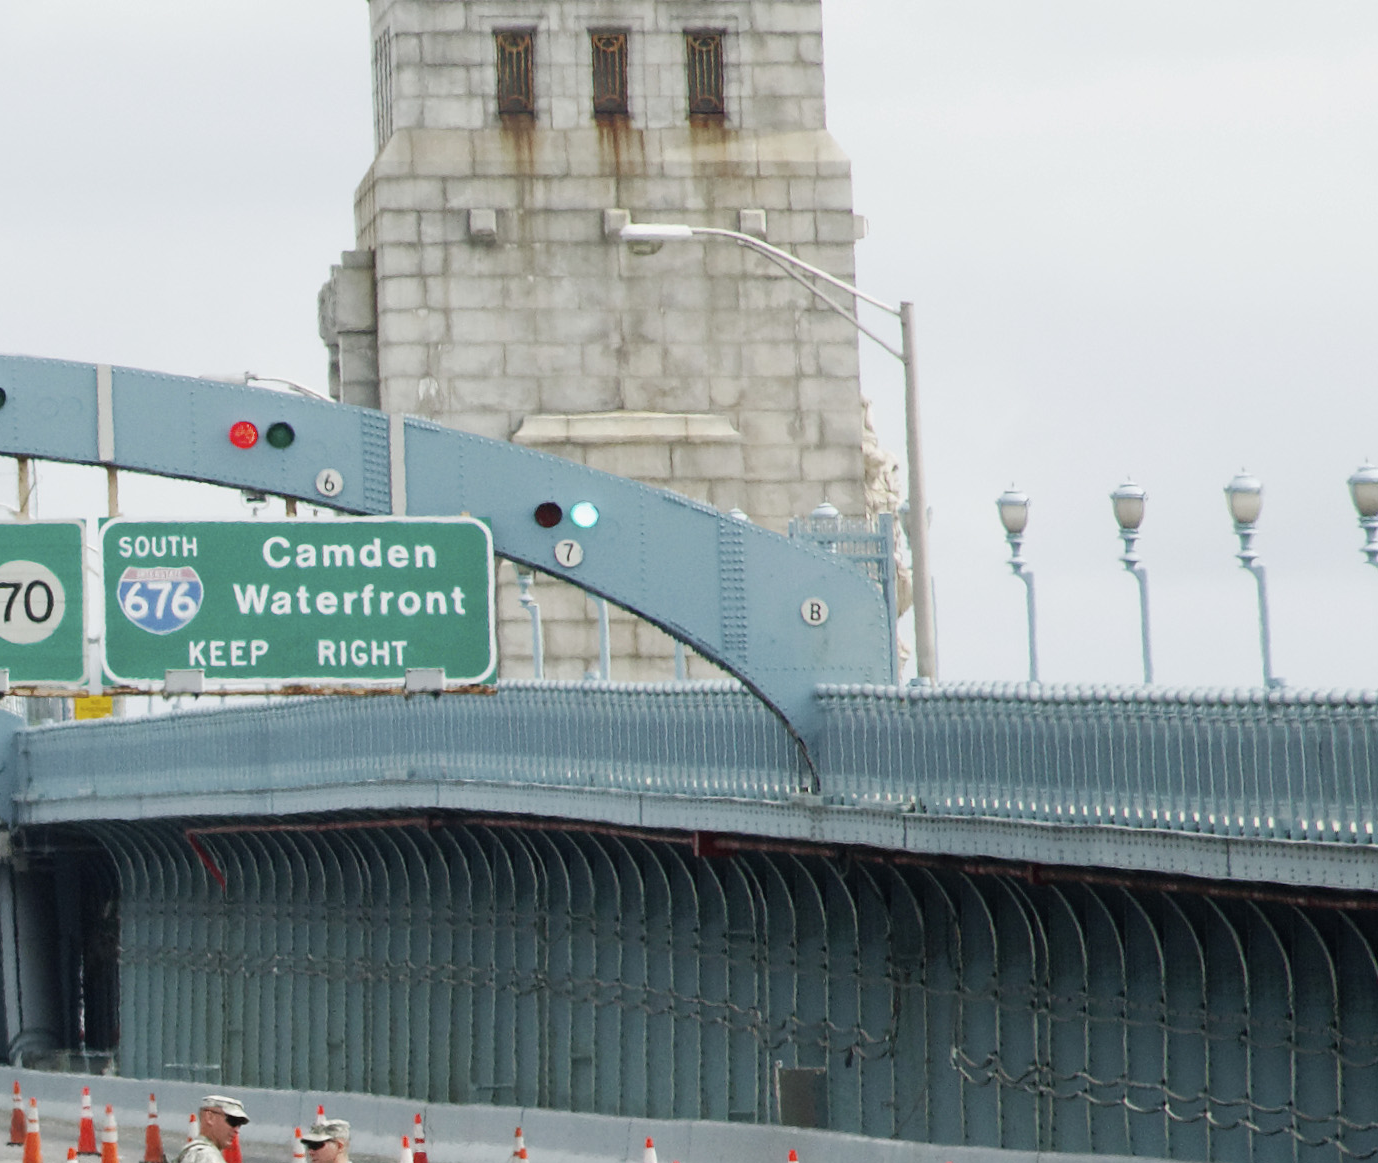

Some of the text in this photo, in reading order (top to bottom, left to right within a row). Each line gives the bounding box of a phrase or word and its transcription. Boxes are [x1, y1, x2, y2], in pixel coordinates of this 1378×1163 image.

[118, 535, 198, 558] SOUTH
[262, 536, 437, 569] Camden
[124, 581, 198, 620] 676
[233, 584, 466, 616] Waterfront
[188, 640, 408, 667] KEEP RIGHT
